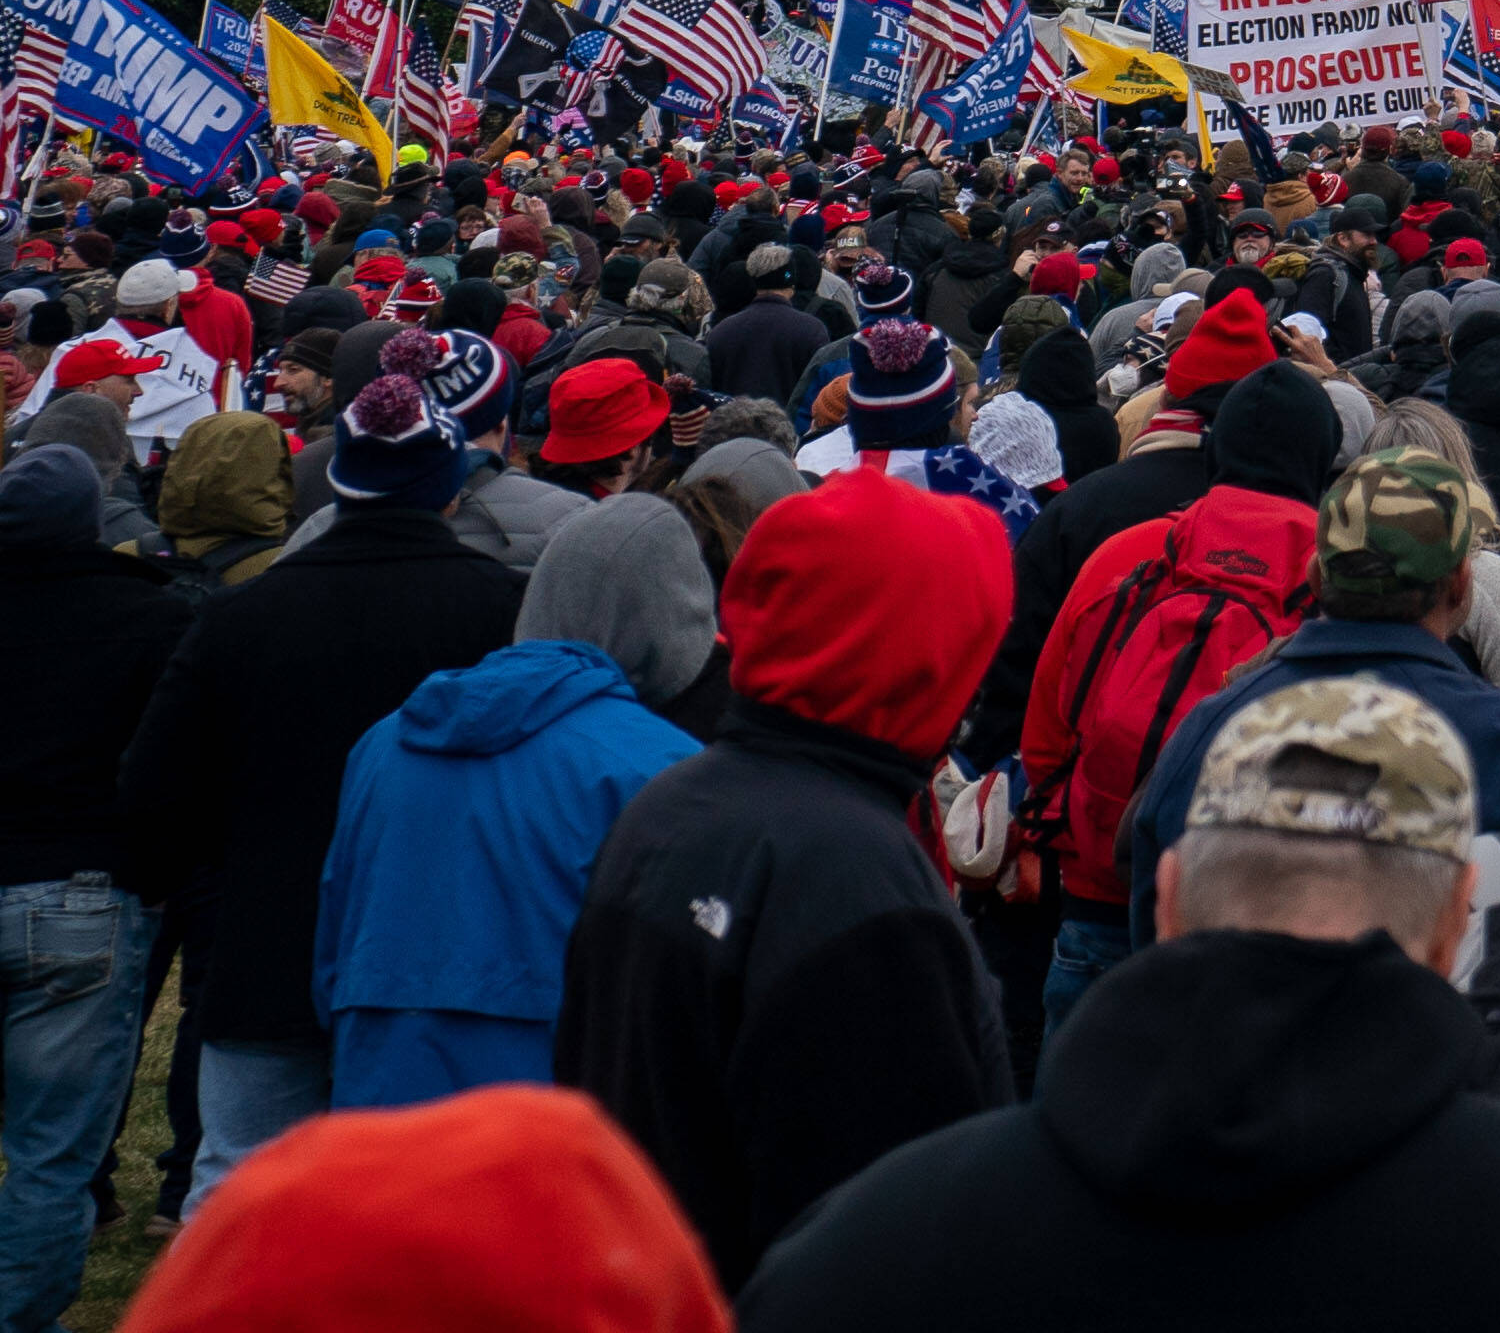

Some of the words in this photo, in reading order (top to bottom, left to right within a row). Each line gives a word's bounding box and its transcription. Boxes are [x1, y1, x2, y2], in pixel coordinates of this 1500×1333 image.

[214, 13, 254, 38] TRU
[1197, 15, 1306, 48] ELECTION
[1312, 7, 1380, 37] FRAUD
[1387, 2, 1435, 26] NOW
[520, 30, 557, 52] LIBERTY
[863, 57, 903, 83] Pen
[1230, 41, 1423, 96] PROSECUTE
[337, 108, 368, 130] TREA
[1277, 99, 1328, 126] WHO
[1334, 94, 1379, 119] ARE
